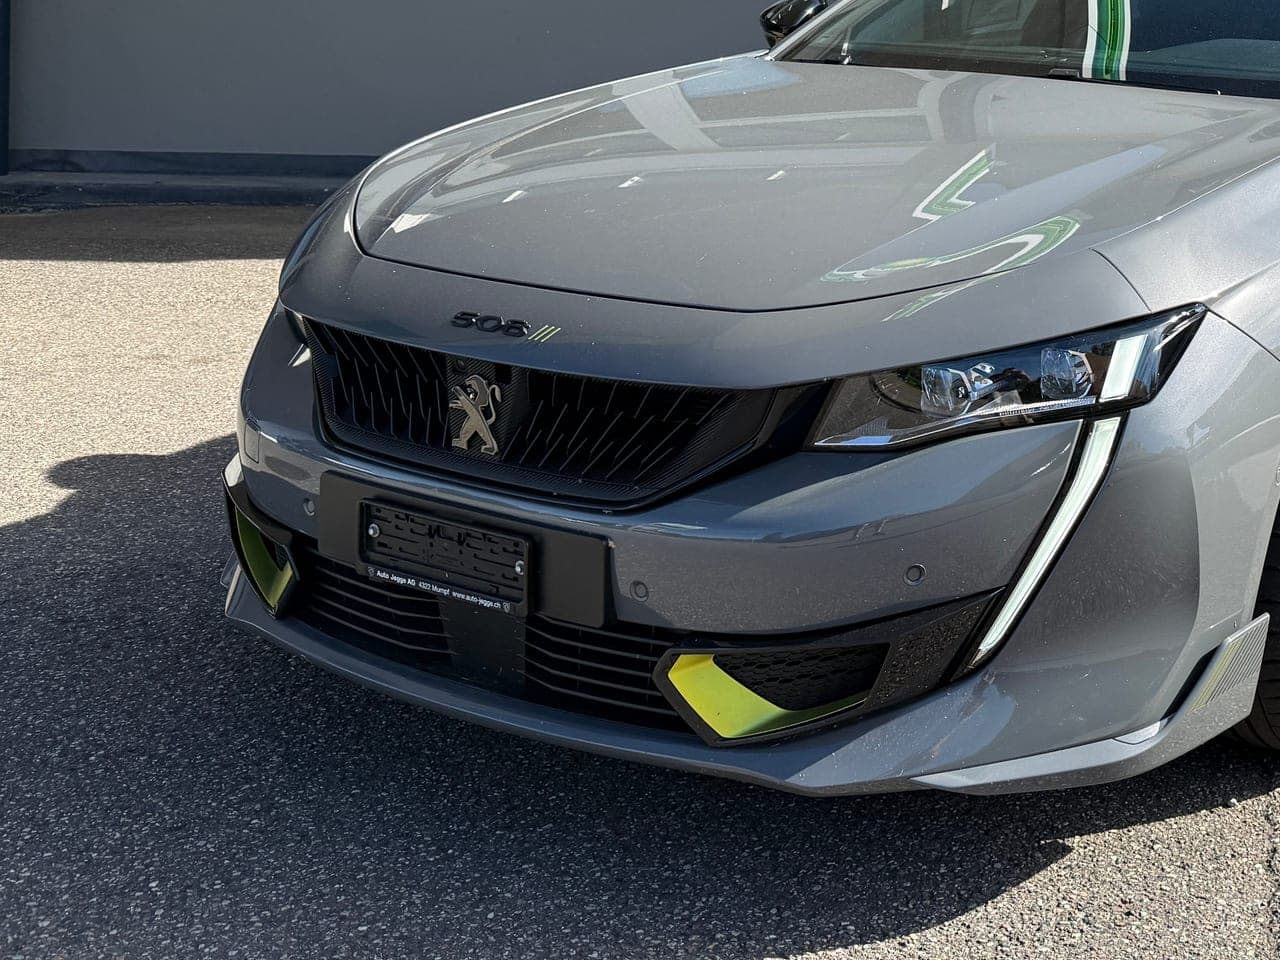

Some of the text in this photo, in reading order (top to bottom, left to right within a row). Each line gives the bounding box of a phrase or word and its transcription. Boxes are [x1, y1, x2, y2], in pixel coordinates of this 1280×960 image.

[450, 310, 531, 337] 508
[376, 569, 390, 579] Auto
[390, 573, 407, 585] Jegge
[407, 578, 416, 586] AG
[418, 581, 431, 590] 4322
[452, 591, 501, 608] www.auto-jegge.ch
